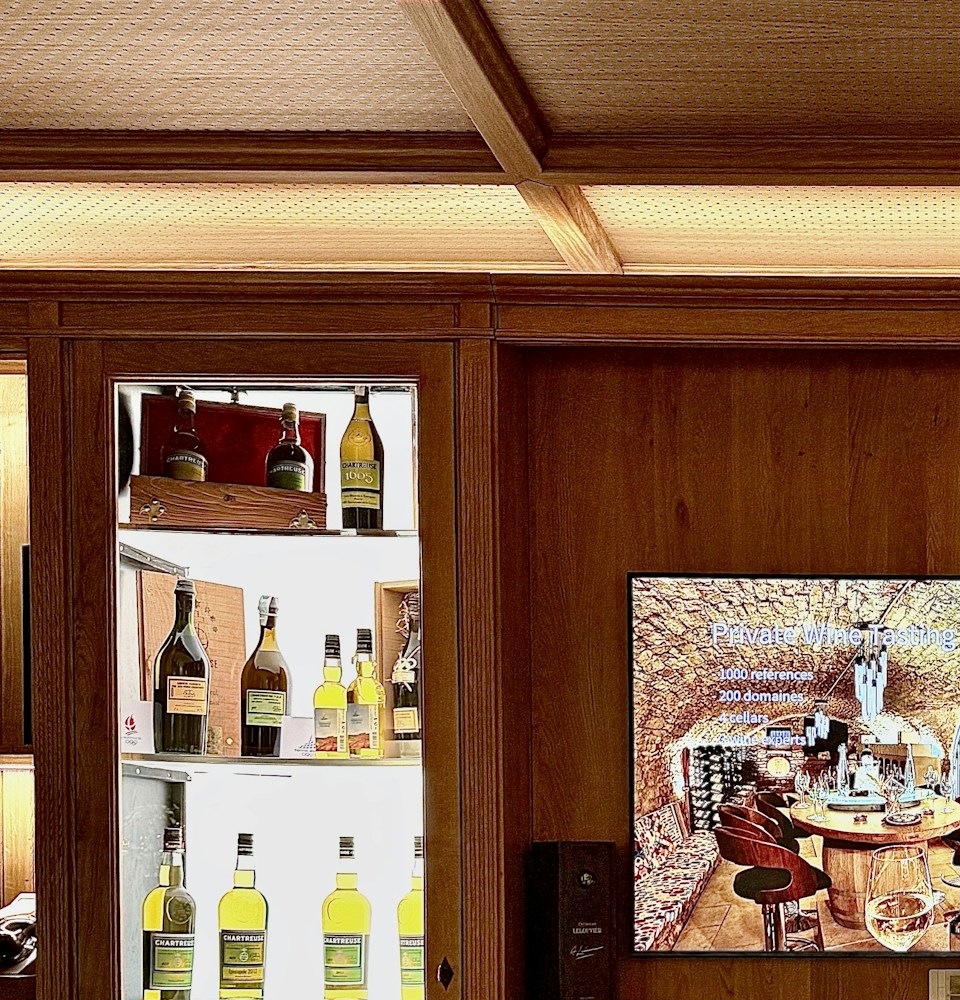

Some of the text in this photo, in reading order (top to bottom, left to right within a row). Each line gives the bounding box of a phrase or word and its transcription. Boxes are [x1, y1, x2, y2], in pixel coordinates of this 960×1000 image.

[711, 623, 957, 652] Private Wine Tasting
[720, 668, 814, 680] 1000 references
[719, 690, 804, 702] 200 domaines
[719, 711, 769, 724] 4 cellars
[730, 734, 758, 745] wine
[761, 734, 807, 747] experts
[222, 935, 265, 943] CHARTREUSE
